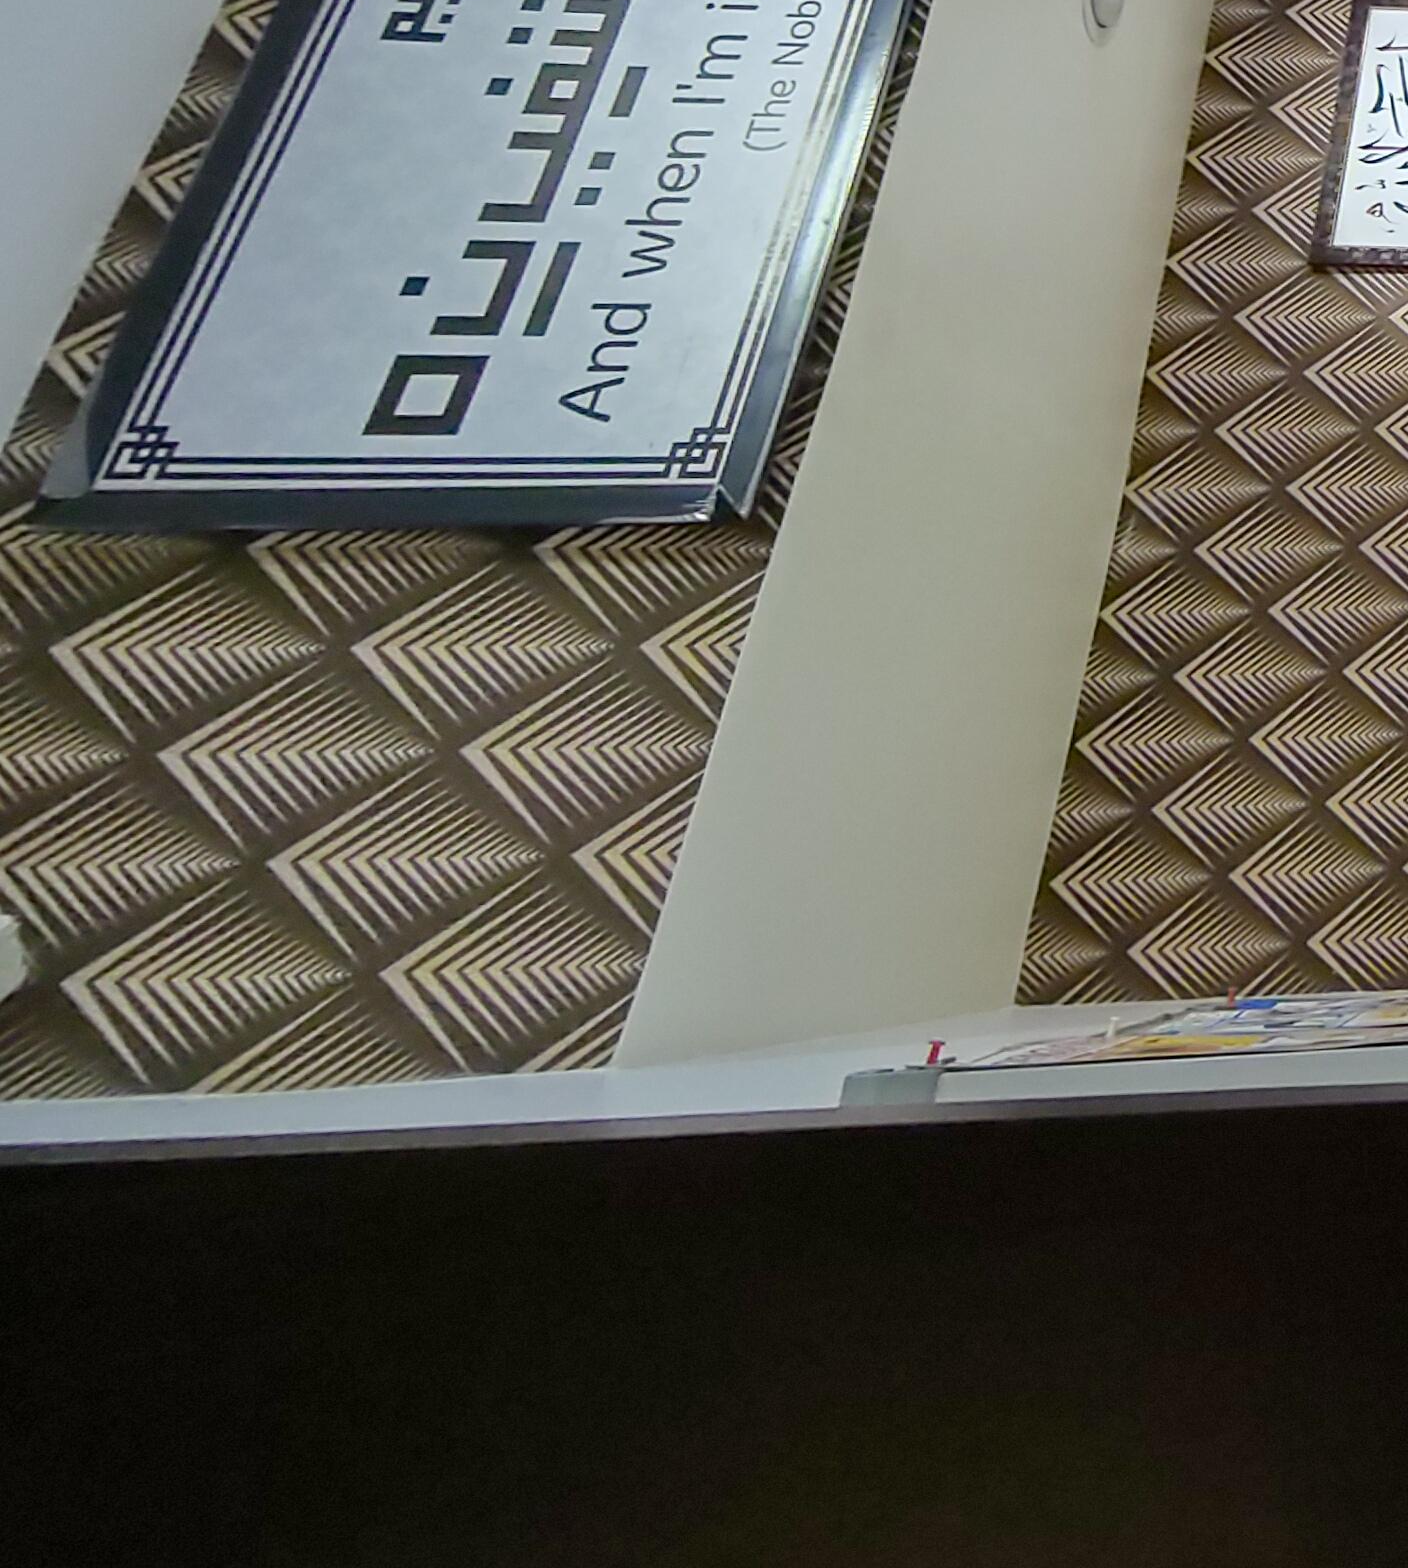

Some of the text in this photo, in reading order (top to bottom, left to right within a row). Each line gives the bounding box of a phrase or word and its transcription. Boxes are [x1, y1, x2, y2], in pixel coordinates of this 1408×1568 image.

[558, 303, 652, 422] And
[621, 131, 714, 278] when
[672, 35, 748, 104] I'm
[742, 80, 797, 152] (The
